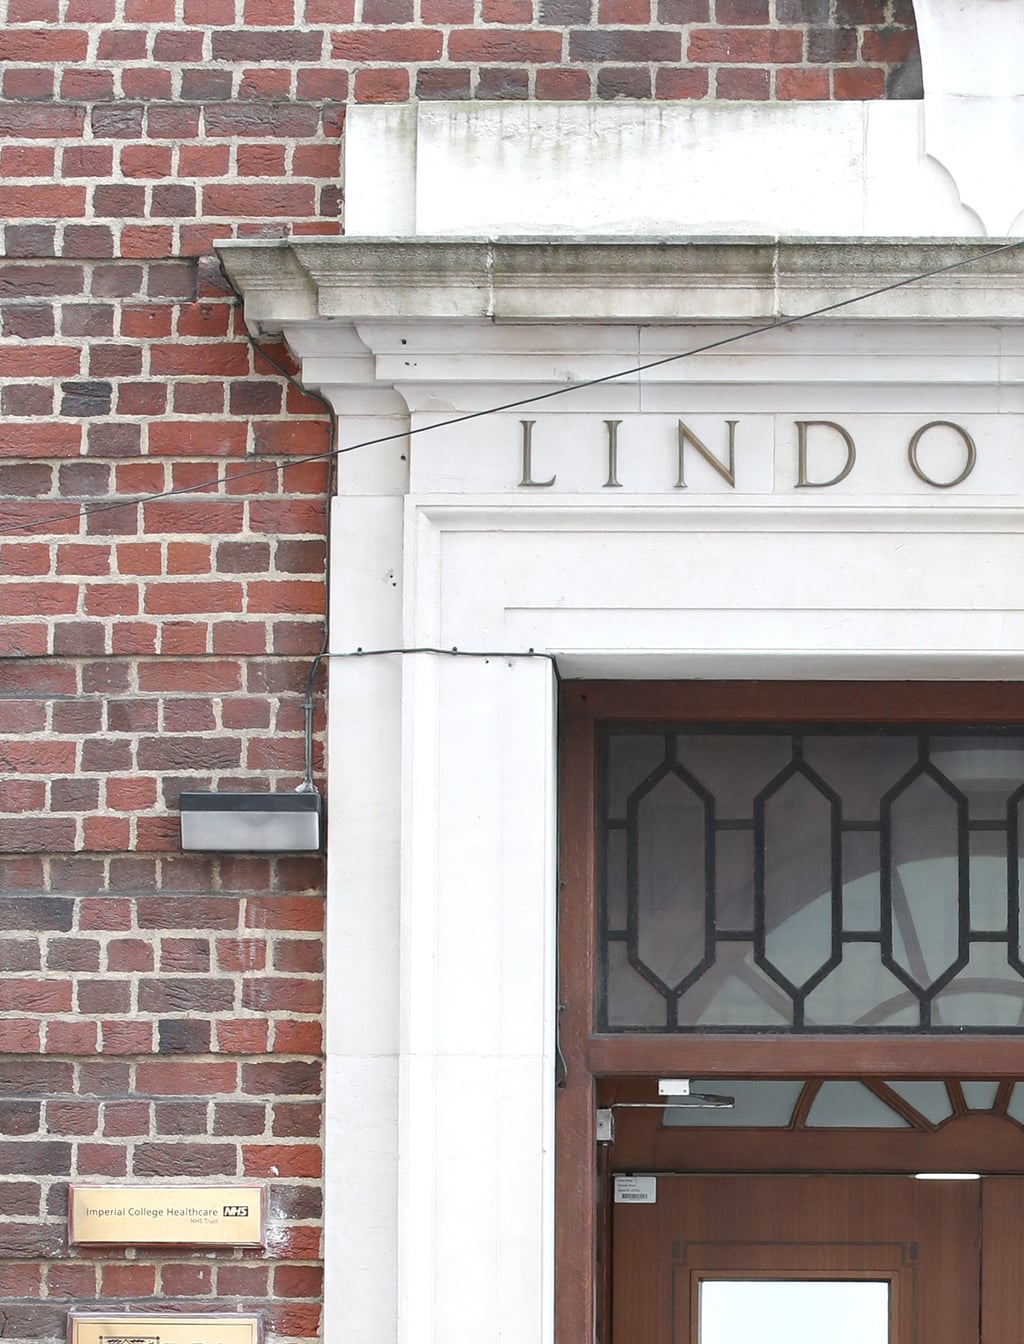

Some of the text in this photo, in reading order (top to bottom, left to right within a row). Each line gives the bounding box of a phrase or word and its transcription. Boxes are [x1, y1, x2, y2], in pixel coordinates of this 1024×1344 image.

[518, 418, 978, 489] LINDO
[86, 1206, 248, 1218] Imperial College Healthcare NHS
